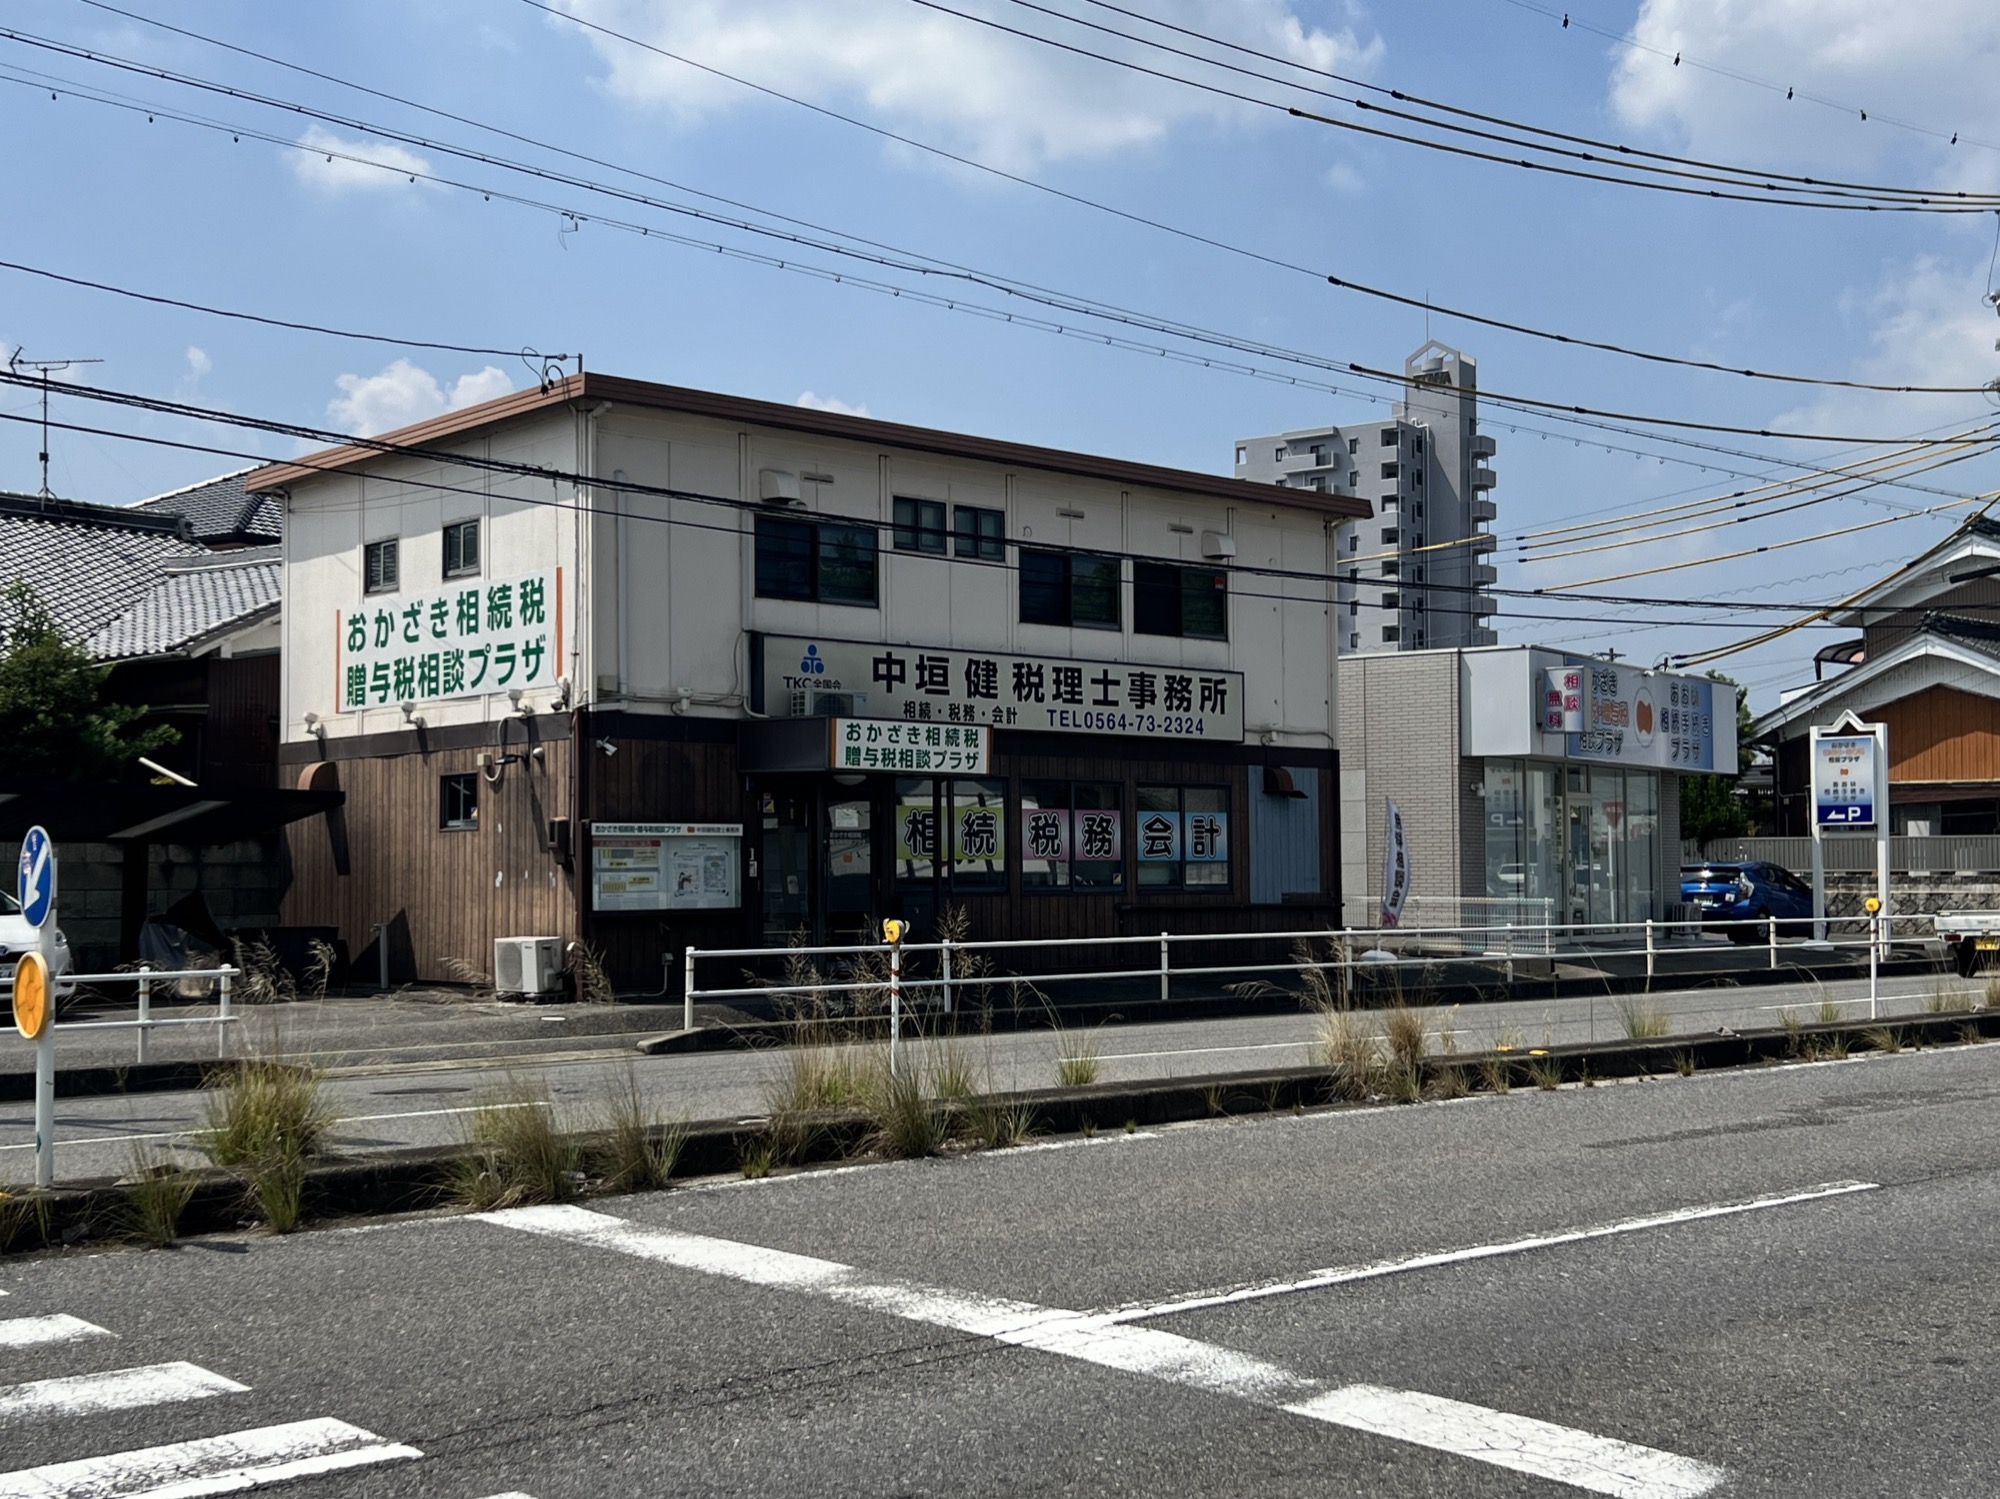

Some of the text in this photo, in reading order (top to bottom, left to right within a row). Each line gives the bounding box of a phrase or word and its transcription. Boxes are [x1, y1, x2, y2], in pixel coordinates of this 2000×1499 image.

[347, 577, 545, 652] おかざき相続税
[346, 634, 547, 706] 贈与税相談プラザ
[872, 651, 1228, 715] 中垣健税理士事務所
[903, 700, 1018, 725] 相続・税務・会計
[1046, 709, 1205, 735] TEL0564-73-2324
[846, 722, 979, 748] おかざき相続税
[845, 745, 980, 772] 贈与税相談プラザ
[1848, 806, 1861, 821] P
